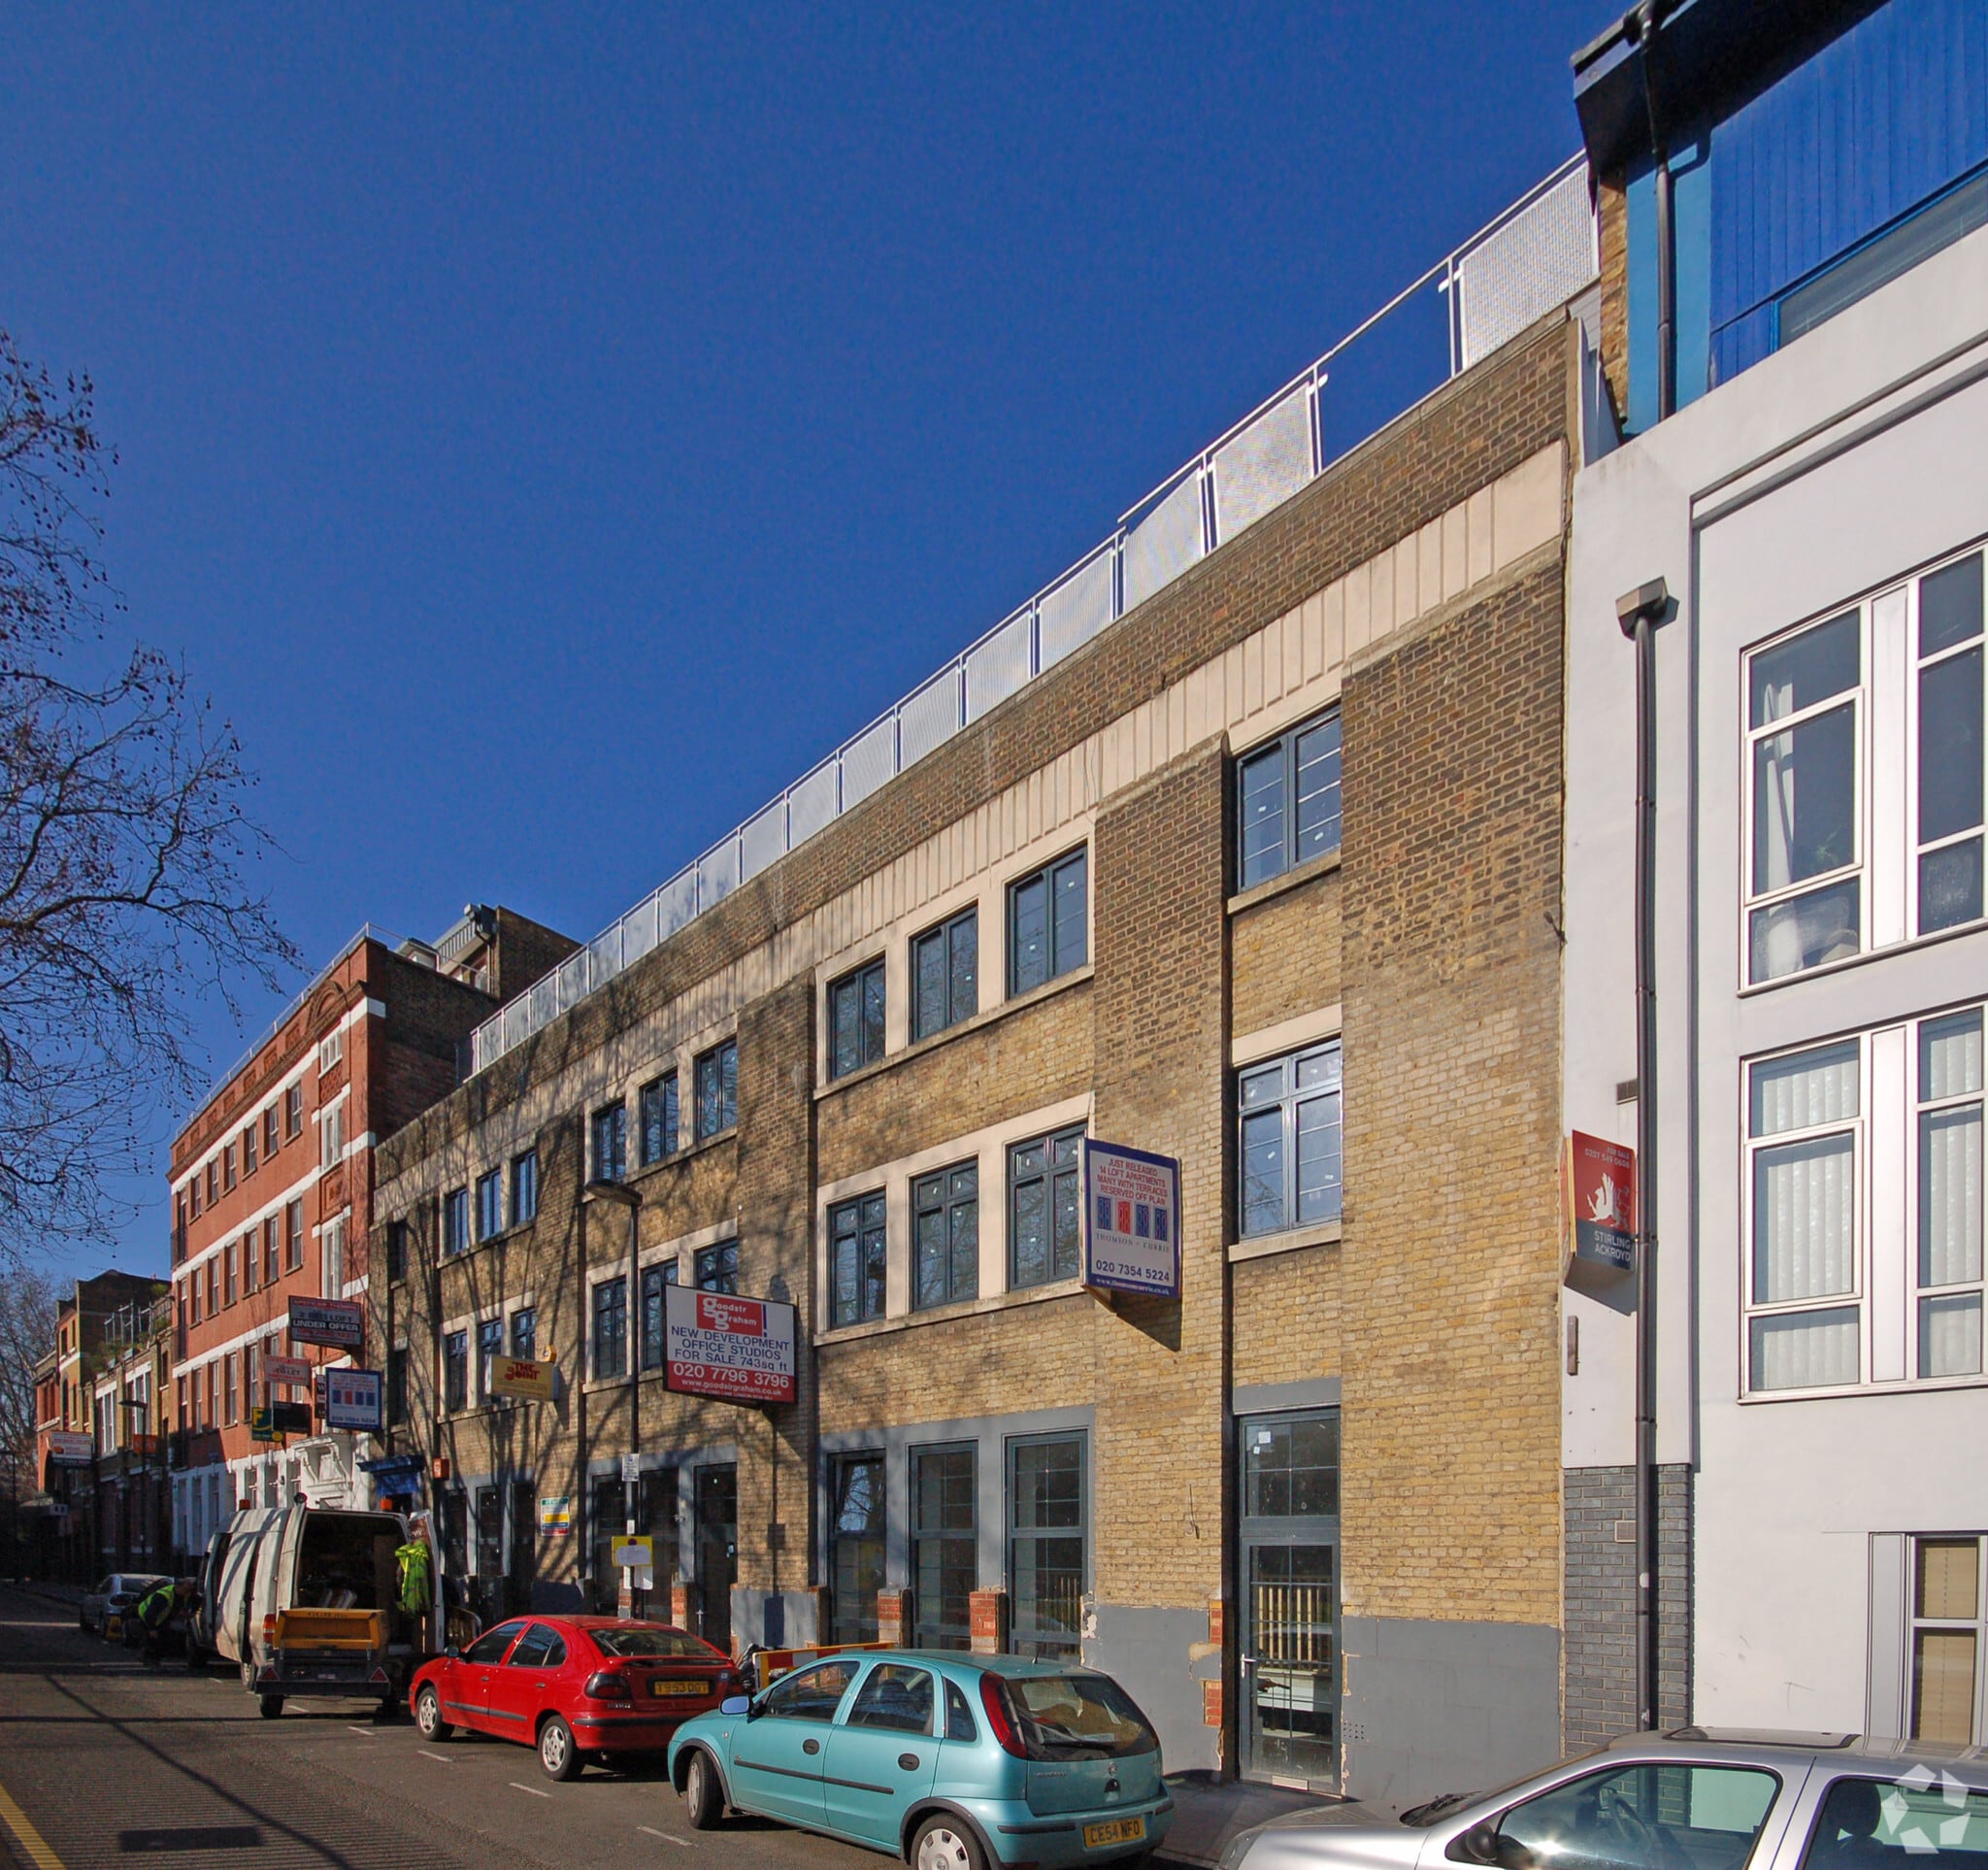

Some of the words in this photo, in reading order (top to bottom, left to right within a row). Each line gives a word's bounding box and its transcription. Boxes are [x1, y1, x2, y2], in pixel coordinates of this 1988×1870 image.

[1108, 1167, 1124, 1178] LOFT
[1126, 1171, 1167, 1187] APARTMENTS
[1109, 1158, 1124, 1169] JUST
[1126, 1161, 1158, 1176] RELEASED
[1097, 1174, 1116, 1185] MANY
[1118, 1179, 1134, 1190] WITH
[1136, 1183, 1168, 1197] TERRACES
[1100, 1184, 1134, 1199] RESERVED
[1135, 1192, 1147, 1201] OFF
[1149, 1195, 1166, 1206] PLAN
[1594, 1230, 1631, 1250] STIRLING
[1594, 1244, 1631, 1261] ACKROYD
[1096, 1259, 1115, 1273] 020
[1118, 1263, 1143, 1277] 7354
[1145, 1268, 1170, 1281] 5224
[703, 1297, 746, 1319] goodsir
[293, 1319, 326, 1329] UNDER
[328, 1322, 358, 1331] OFFER
[714, 1310, 757, 1330] graham
[671, 1325, 699, 1339] NEW
[704, 1331, 789, 1351] DEVELOPMENT
[681, 1339, 725, 1353] OFFICE
[730, 1345, 780, 1360] STUDIOS
[513, 1361, 535, 1371] THE
[675, 1349, 700, 1359] FOR
[706, 1352, 735, 1365] SALE
[741, 1356, 775, 1371] 743sq
[779, 1361, 787, 1371] ft
[505, 1366, 540, 1381] JOINT
[674, 1362, 705, 1378] 020
[711, 1367, 747, 1383] 7796
[754, 1372, 789, 1388] 3796
[681, 1379, 781, 1396] www.goodsirgraham.co.uk
[1090, 1825, 1118, 1844] CE54
[1120, 1820, 1141, 1838] NFO
